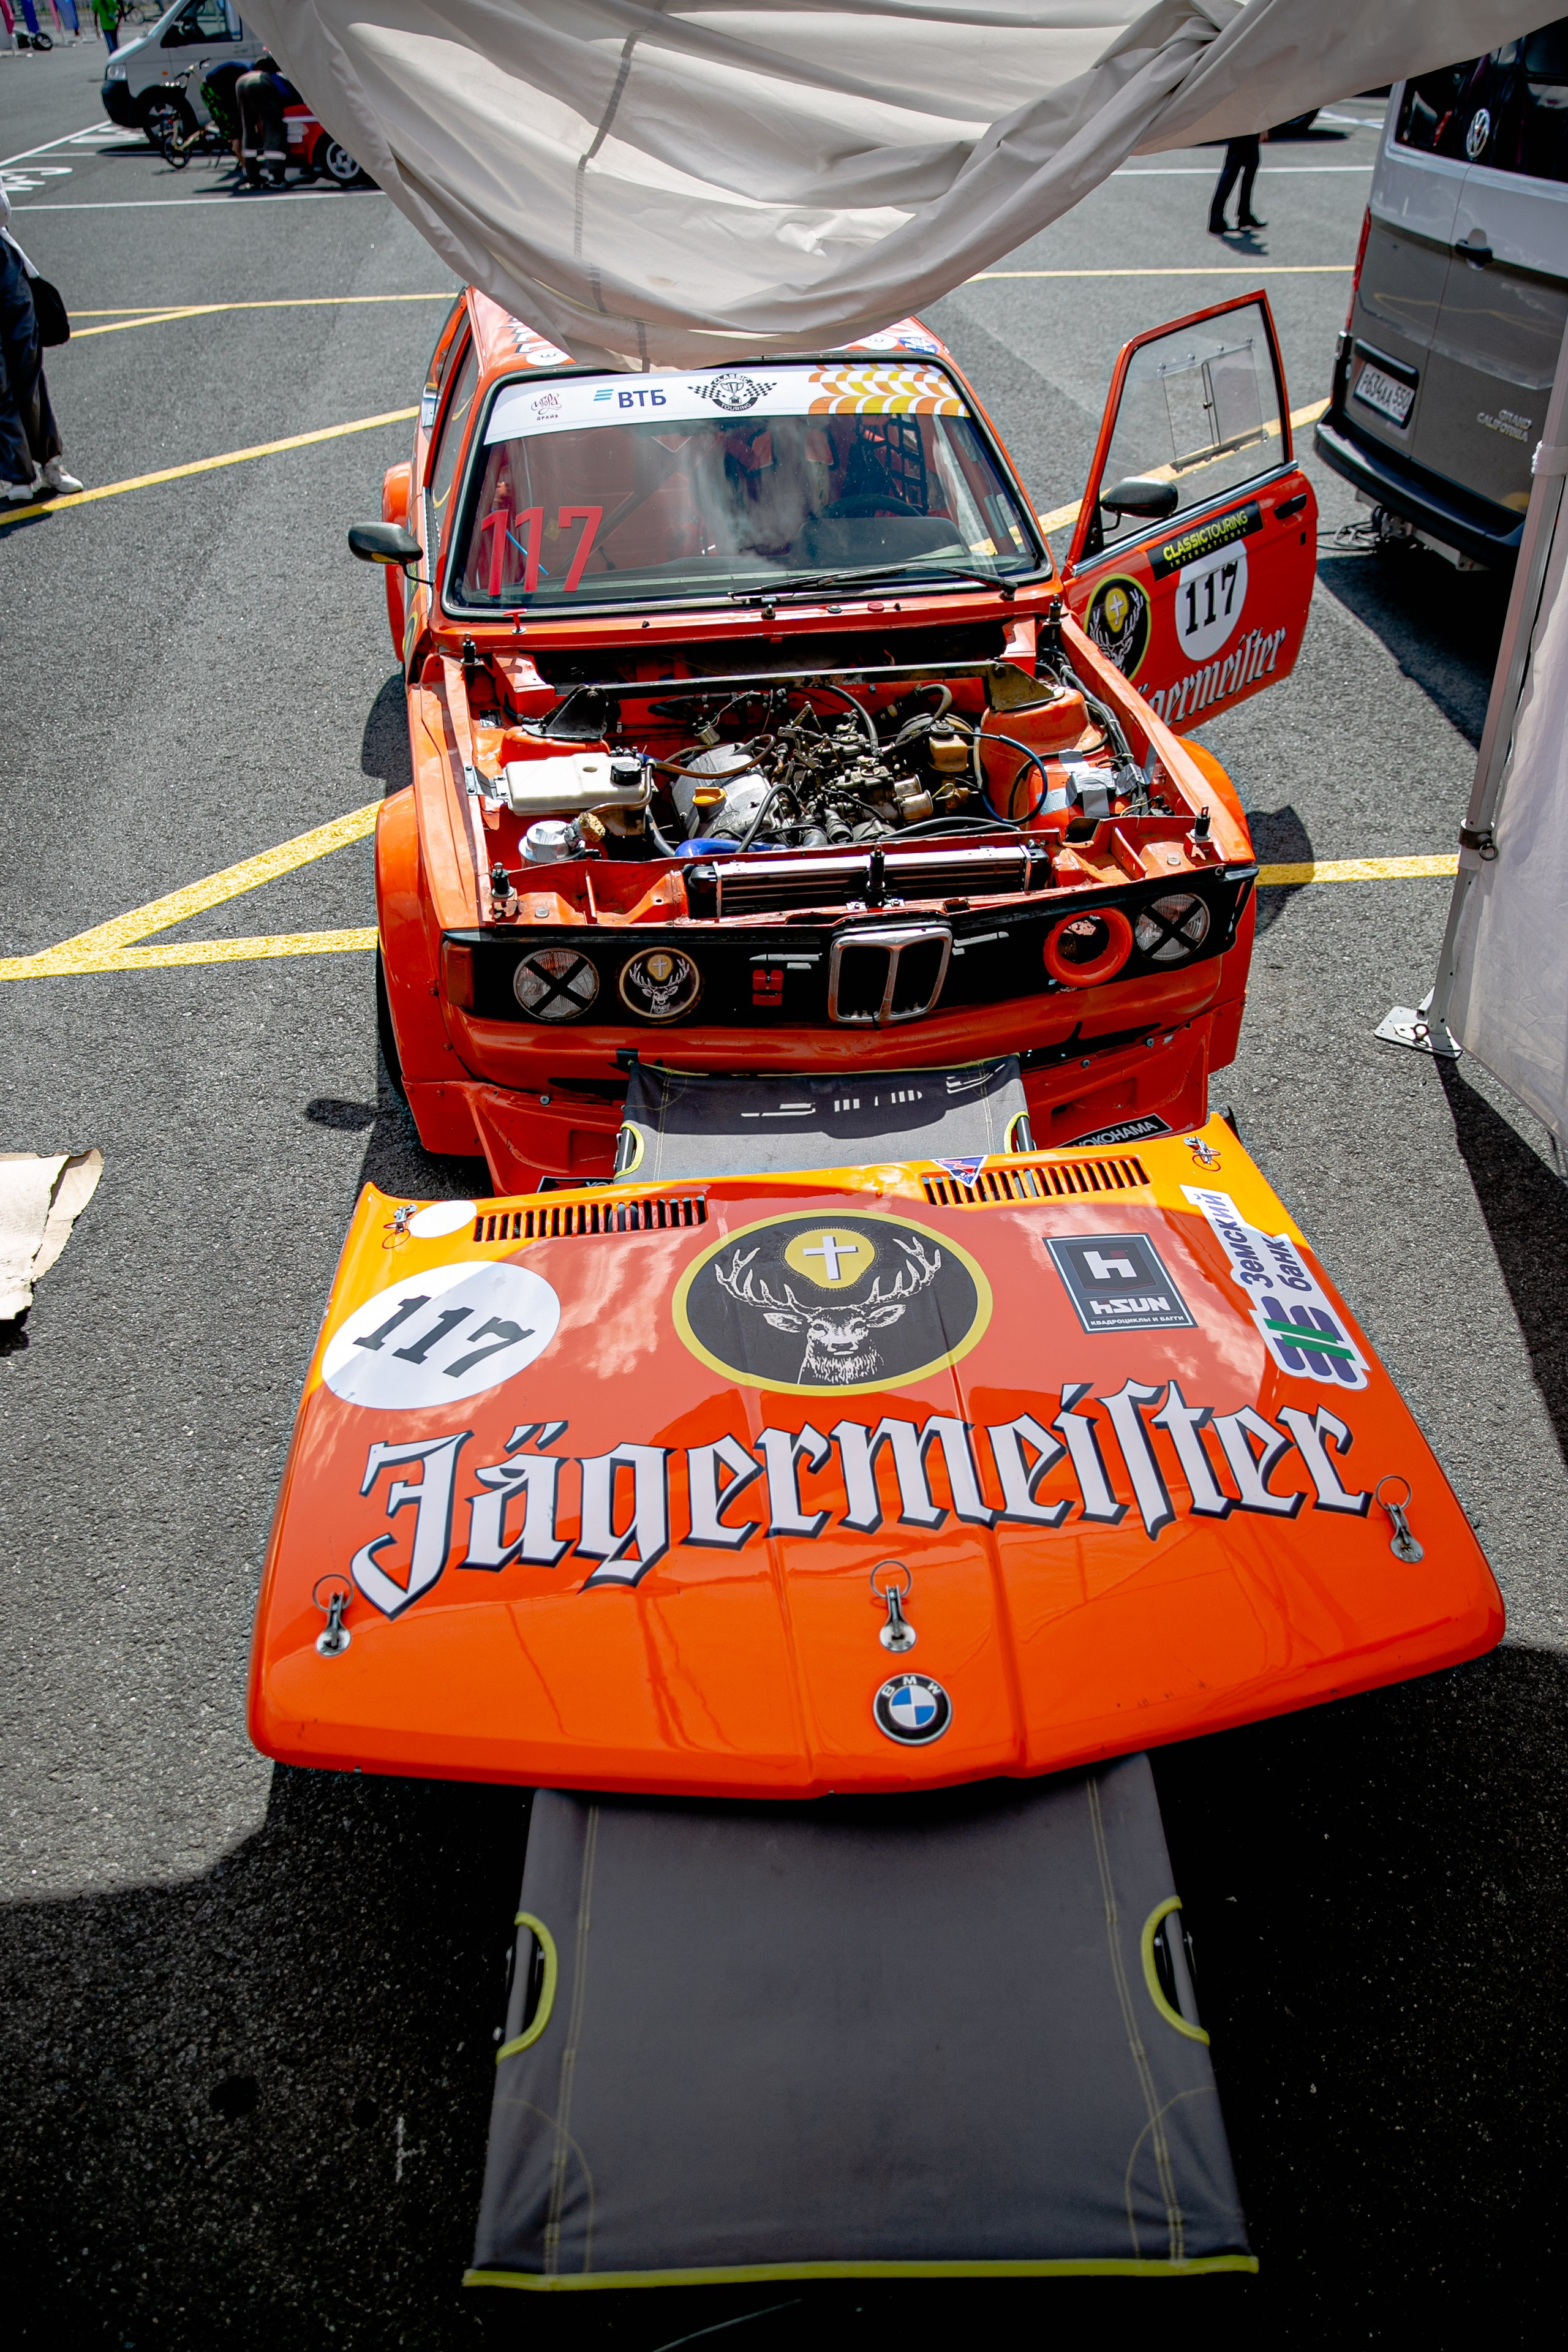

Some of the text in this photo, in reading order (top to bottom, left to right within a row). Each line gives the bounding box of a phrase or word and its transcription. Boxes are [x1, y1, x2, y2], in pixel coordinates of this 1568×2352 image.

[713, 374, 750, 384] CLASSIC
[618, 389, 666, 408] ВТБ
[1477, 412, 1528, 442] CALIFORNIA
[1499, 409, 1532, 430] GRAND
[481, 506, 602, 596] 117
[1170, 527, 1246, 567] INTERNATIONAL
[1185, 560, 1238, 636] 117
[1193, 1193, 1273, 1288] Земский
[1261, 1236, 1312, 1291] банк
[353, 1295, 536, 1378] 117
[1090, 1317, 1151, 1325] КВАДРОЦИКЛЫ
[881, 1676, 941, 1697] BMW
